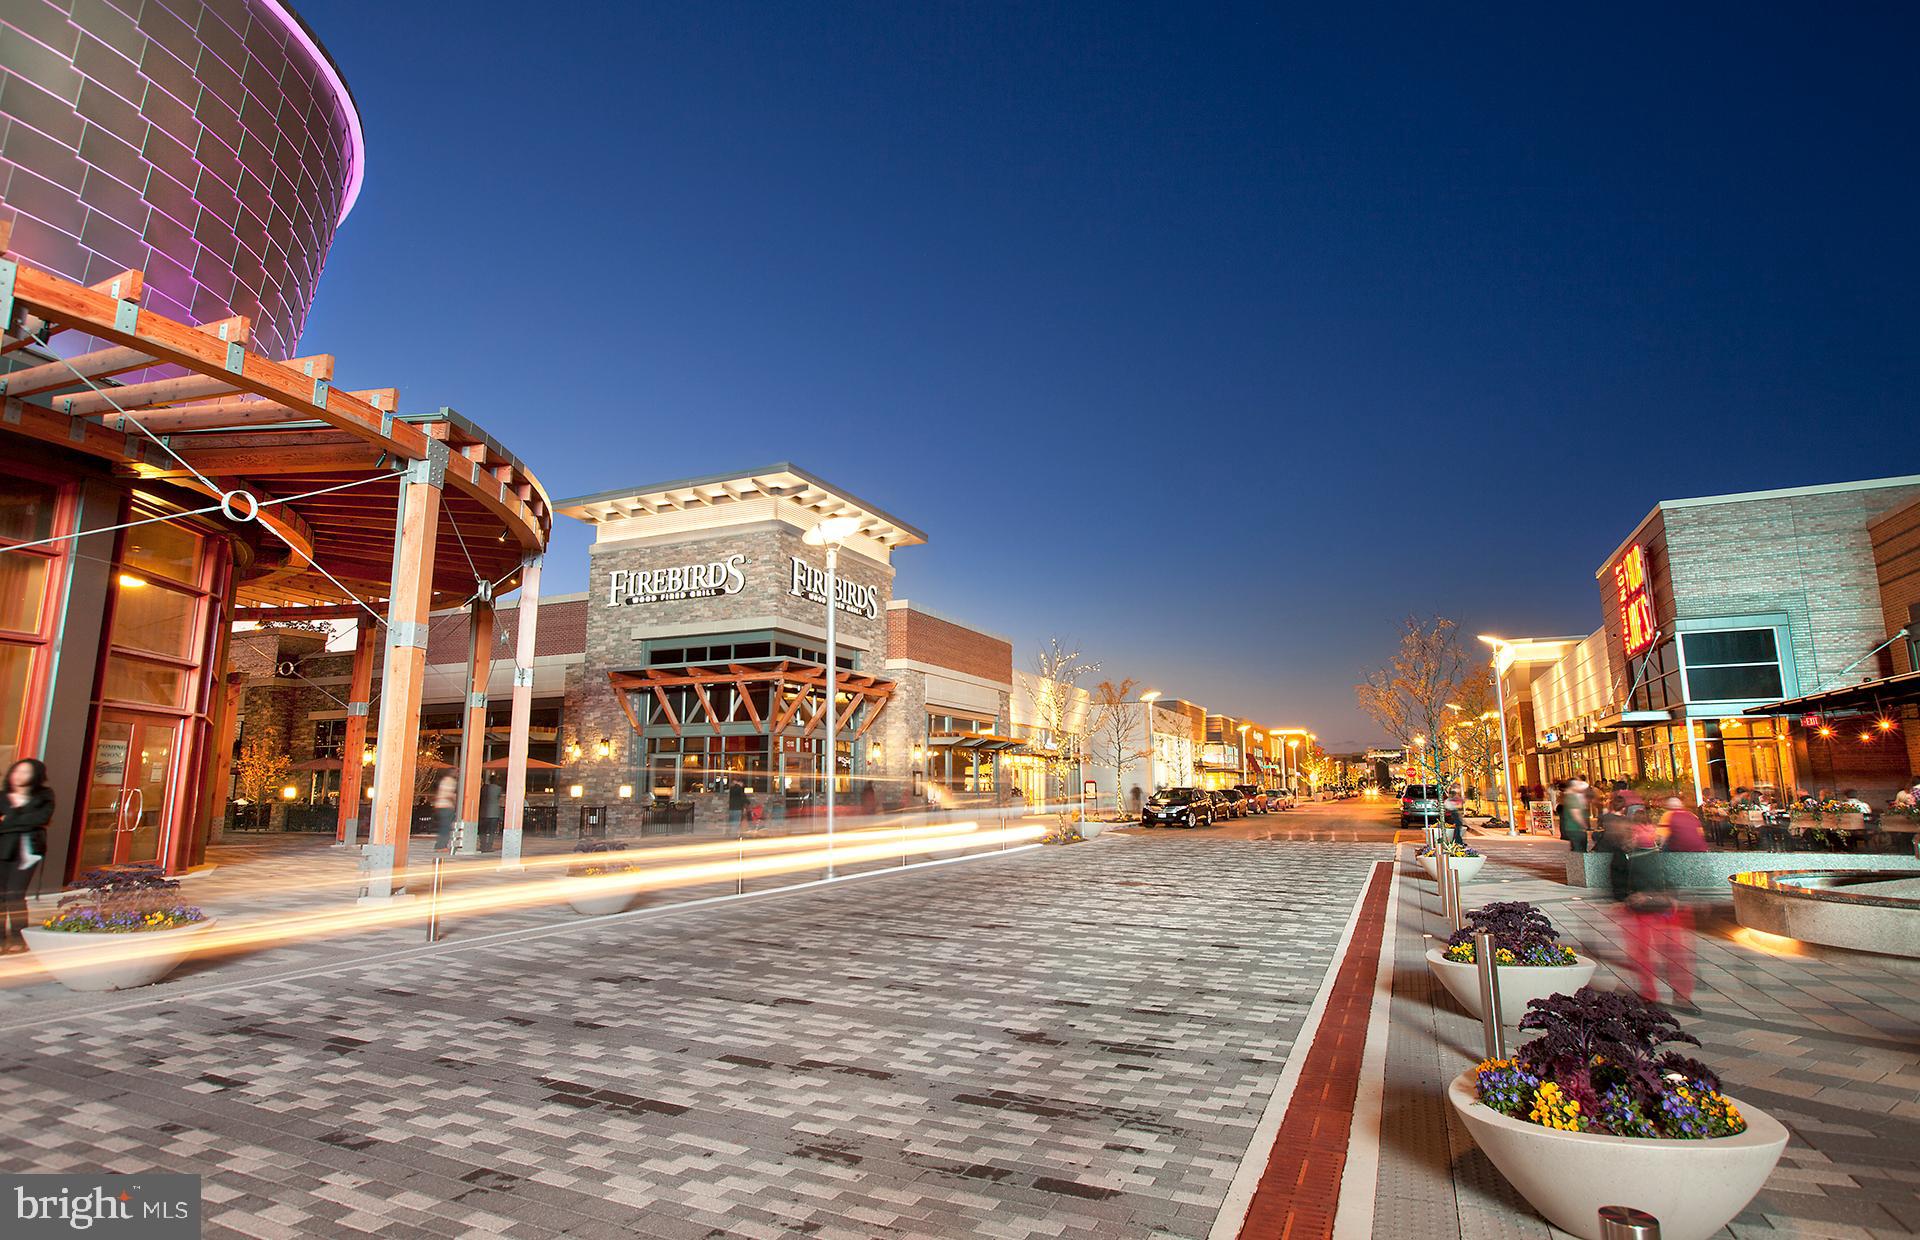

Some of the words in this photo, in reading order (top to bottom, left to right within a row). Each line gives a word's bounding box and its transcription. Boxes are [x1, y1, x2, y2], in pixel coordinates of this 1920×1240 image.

[607, 553, 746, 607] FIREBIRDS
[632, 595, 657, 604] WOOD
[660, 591, 687, 601] FIRED
[690, 588, 717, 598] GRILL
[1805, 717, 1818, 726] EXIT
